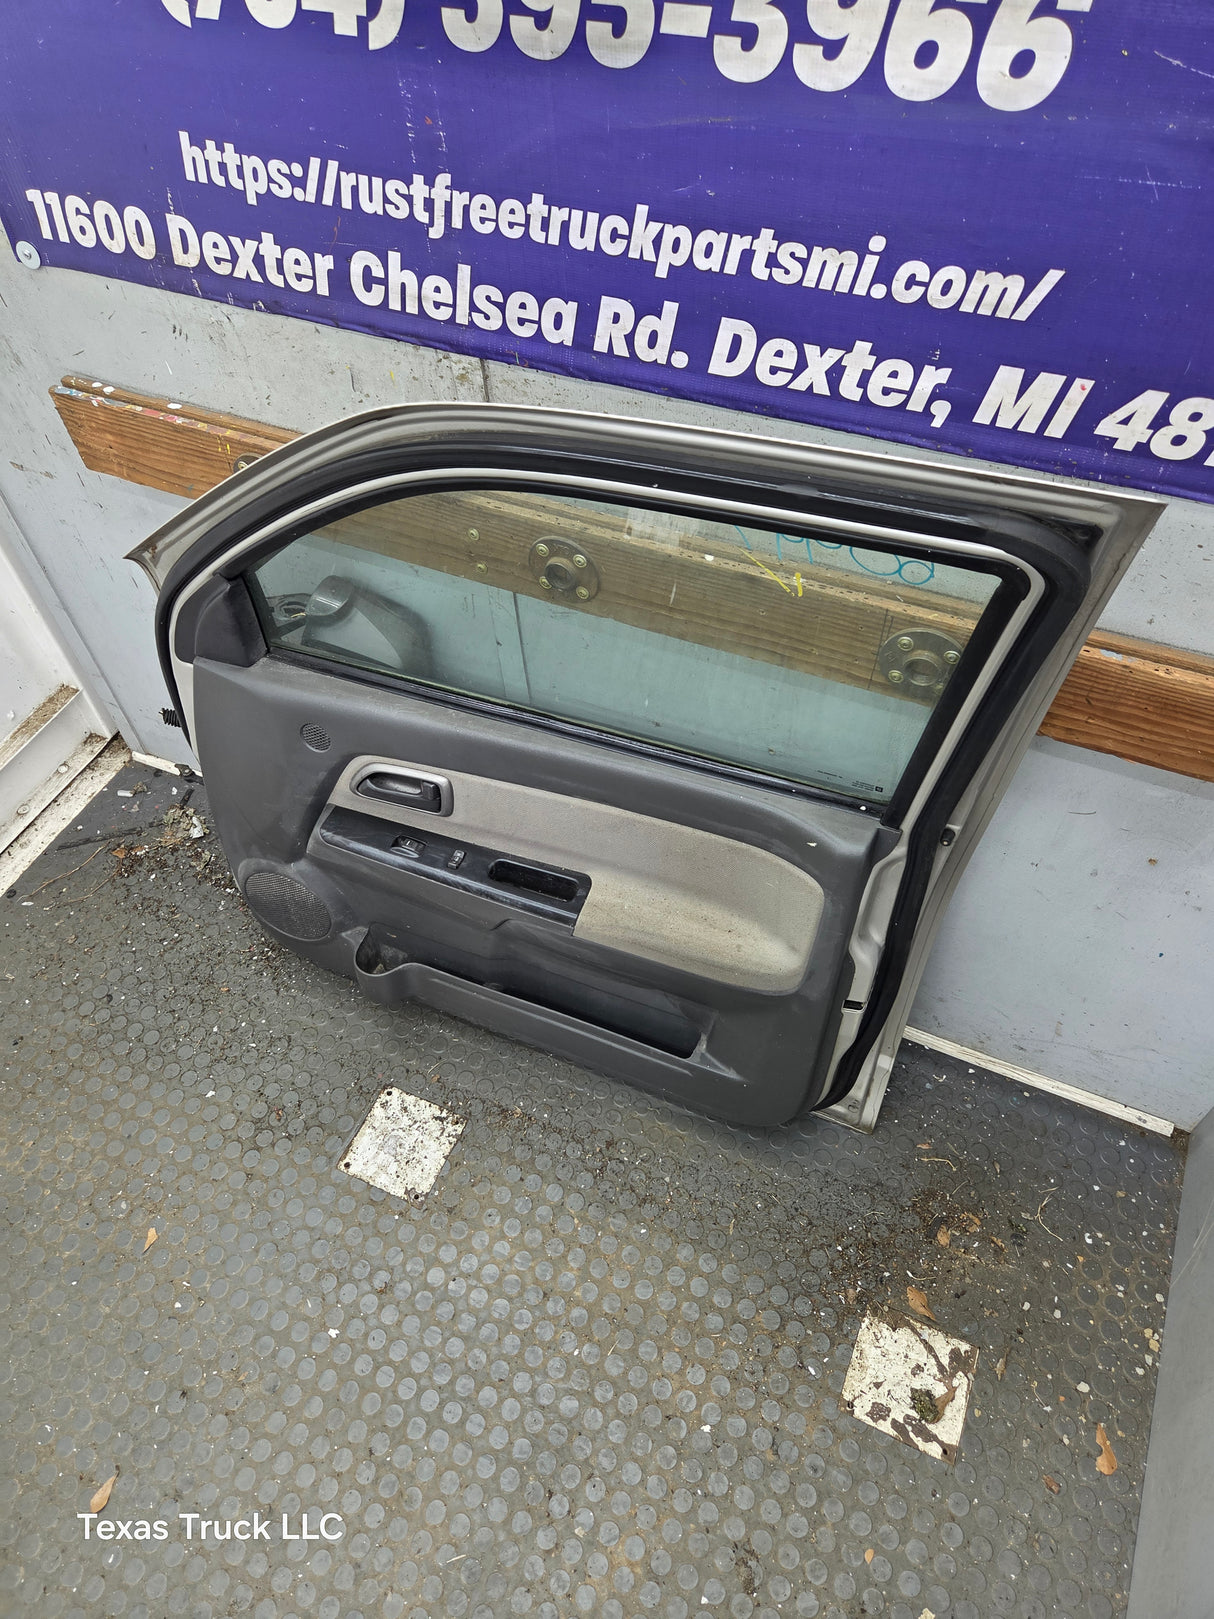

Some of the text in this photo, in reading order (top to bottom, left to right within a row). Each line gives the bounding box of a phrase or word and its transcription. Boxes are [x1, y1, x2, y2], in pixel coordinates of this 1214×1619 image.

[25, 189, 1214, 468] 11600 Dexter Chelsea Rd. Dexter, MI 48
[178, 131, 1065, 321] https://rustfreetruckpartsmi.com/
